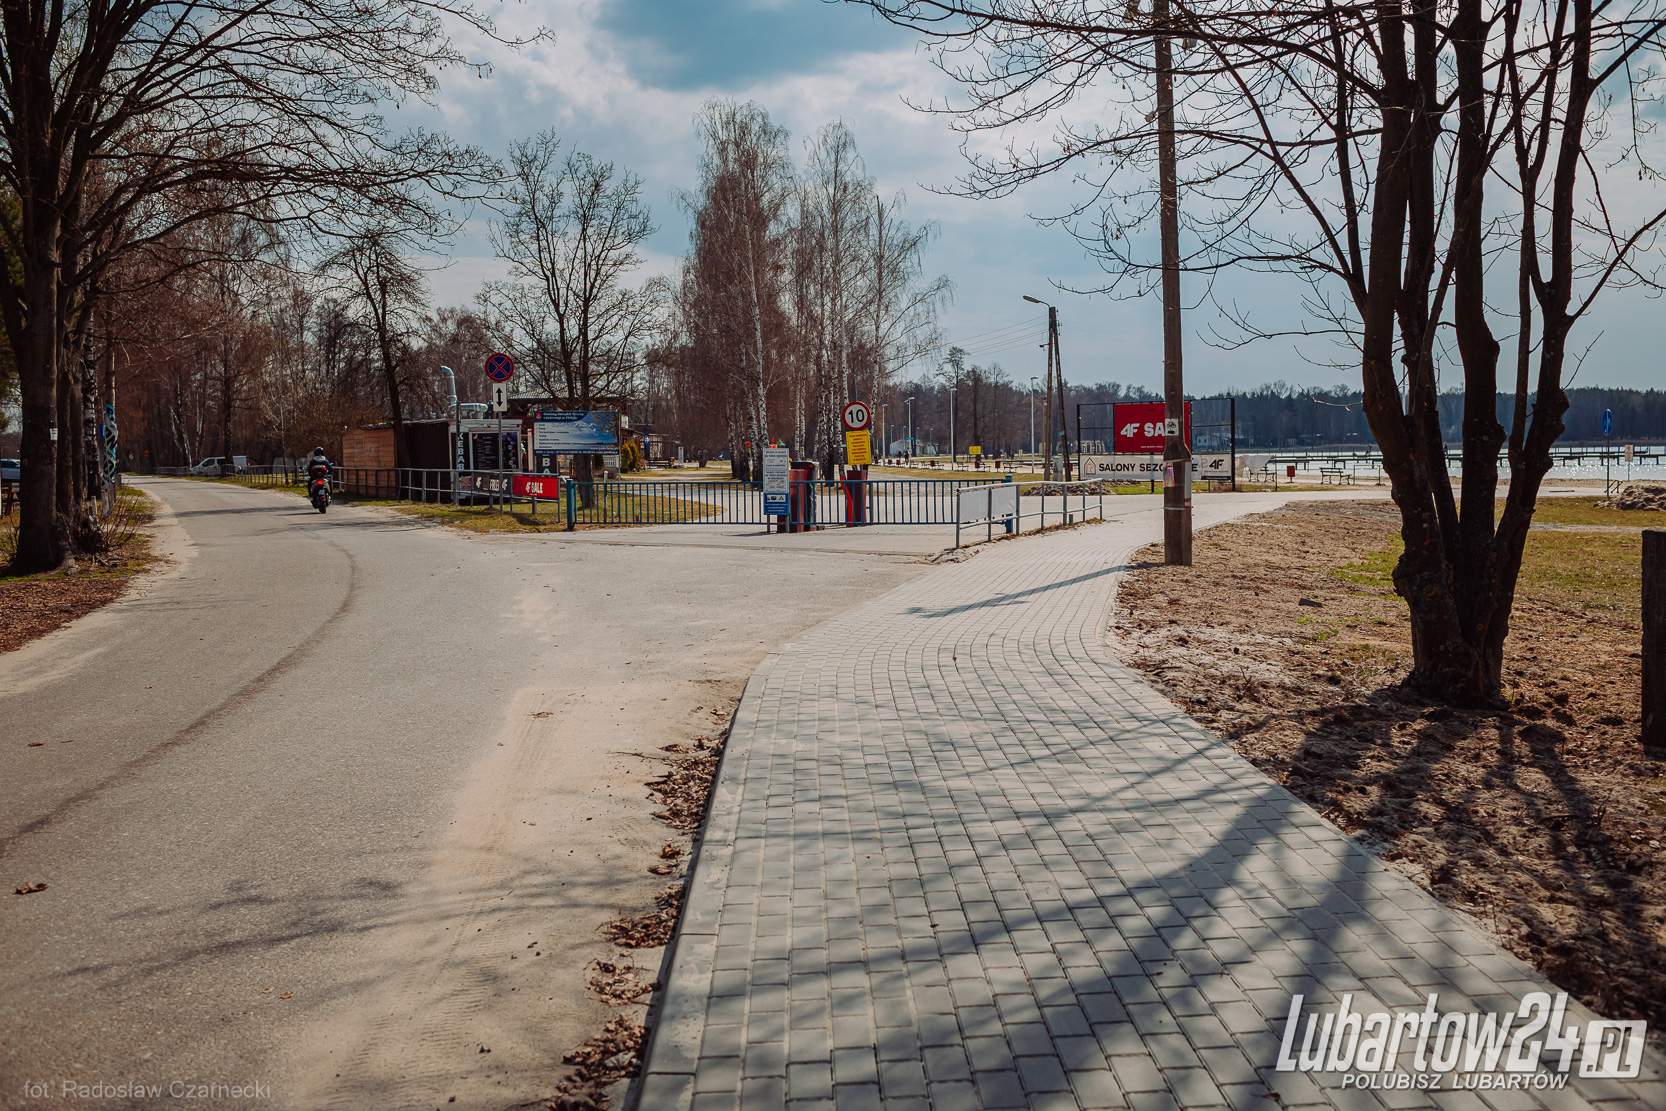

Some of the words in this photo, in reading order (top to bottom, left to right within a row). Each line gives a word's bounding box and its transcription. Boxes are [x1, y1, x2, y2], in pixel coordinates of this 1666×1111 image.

[848, 409, 865, 423] 10
[1120, 423, 1140, 438] 4F
[456, 432, 465, 471] KEBAB
[1098, 463, 1136, 472] SALONY
[1208, 459, 1225, 470] 4F
